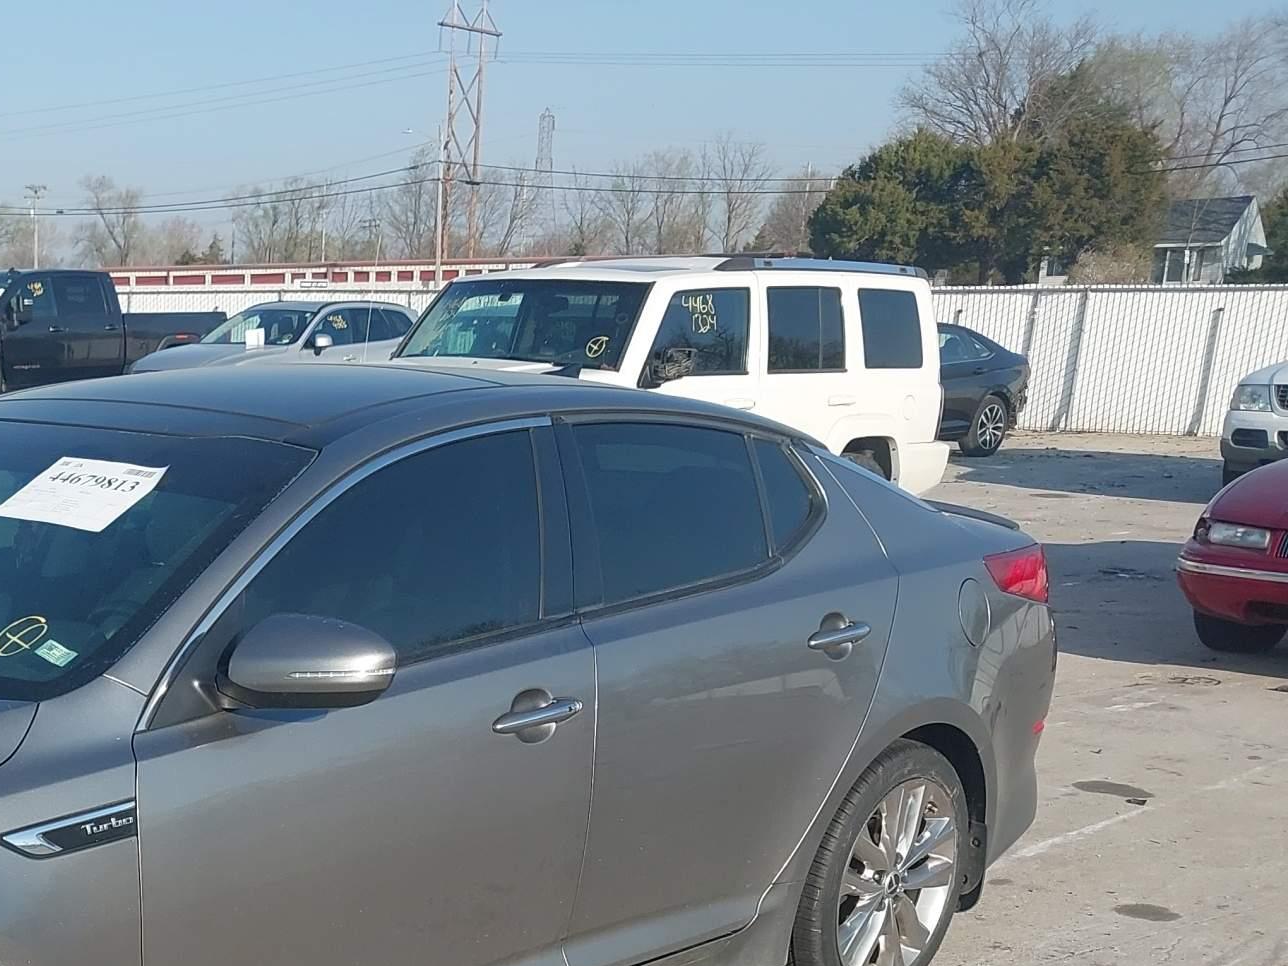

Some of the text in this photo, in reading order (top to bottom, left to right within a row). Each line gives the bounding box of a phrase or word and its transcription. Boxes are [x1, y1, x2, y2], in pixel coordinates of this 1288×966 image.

[681, 294, 715, 315] 4468
[49, 470, 140, 493] 44679813
[80, 816, 134, 836] Turbo
